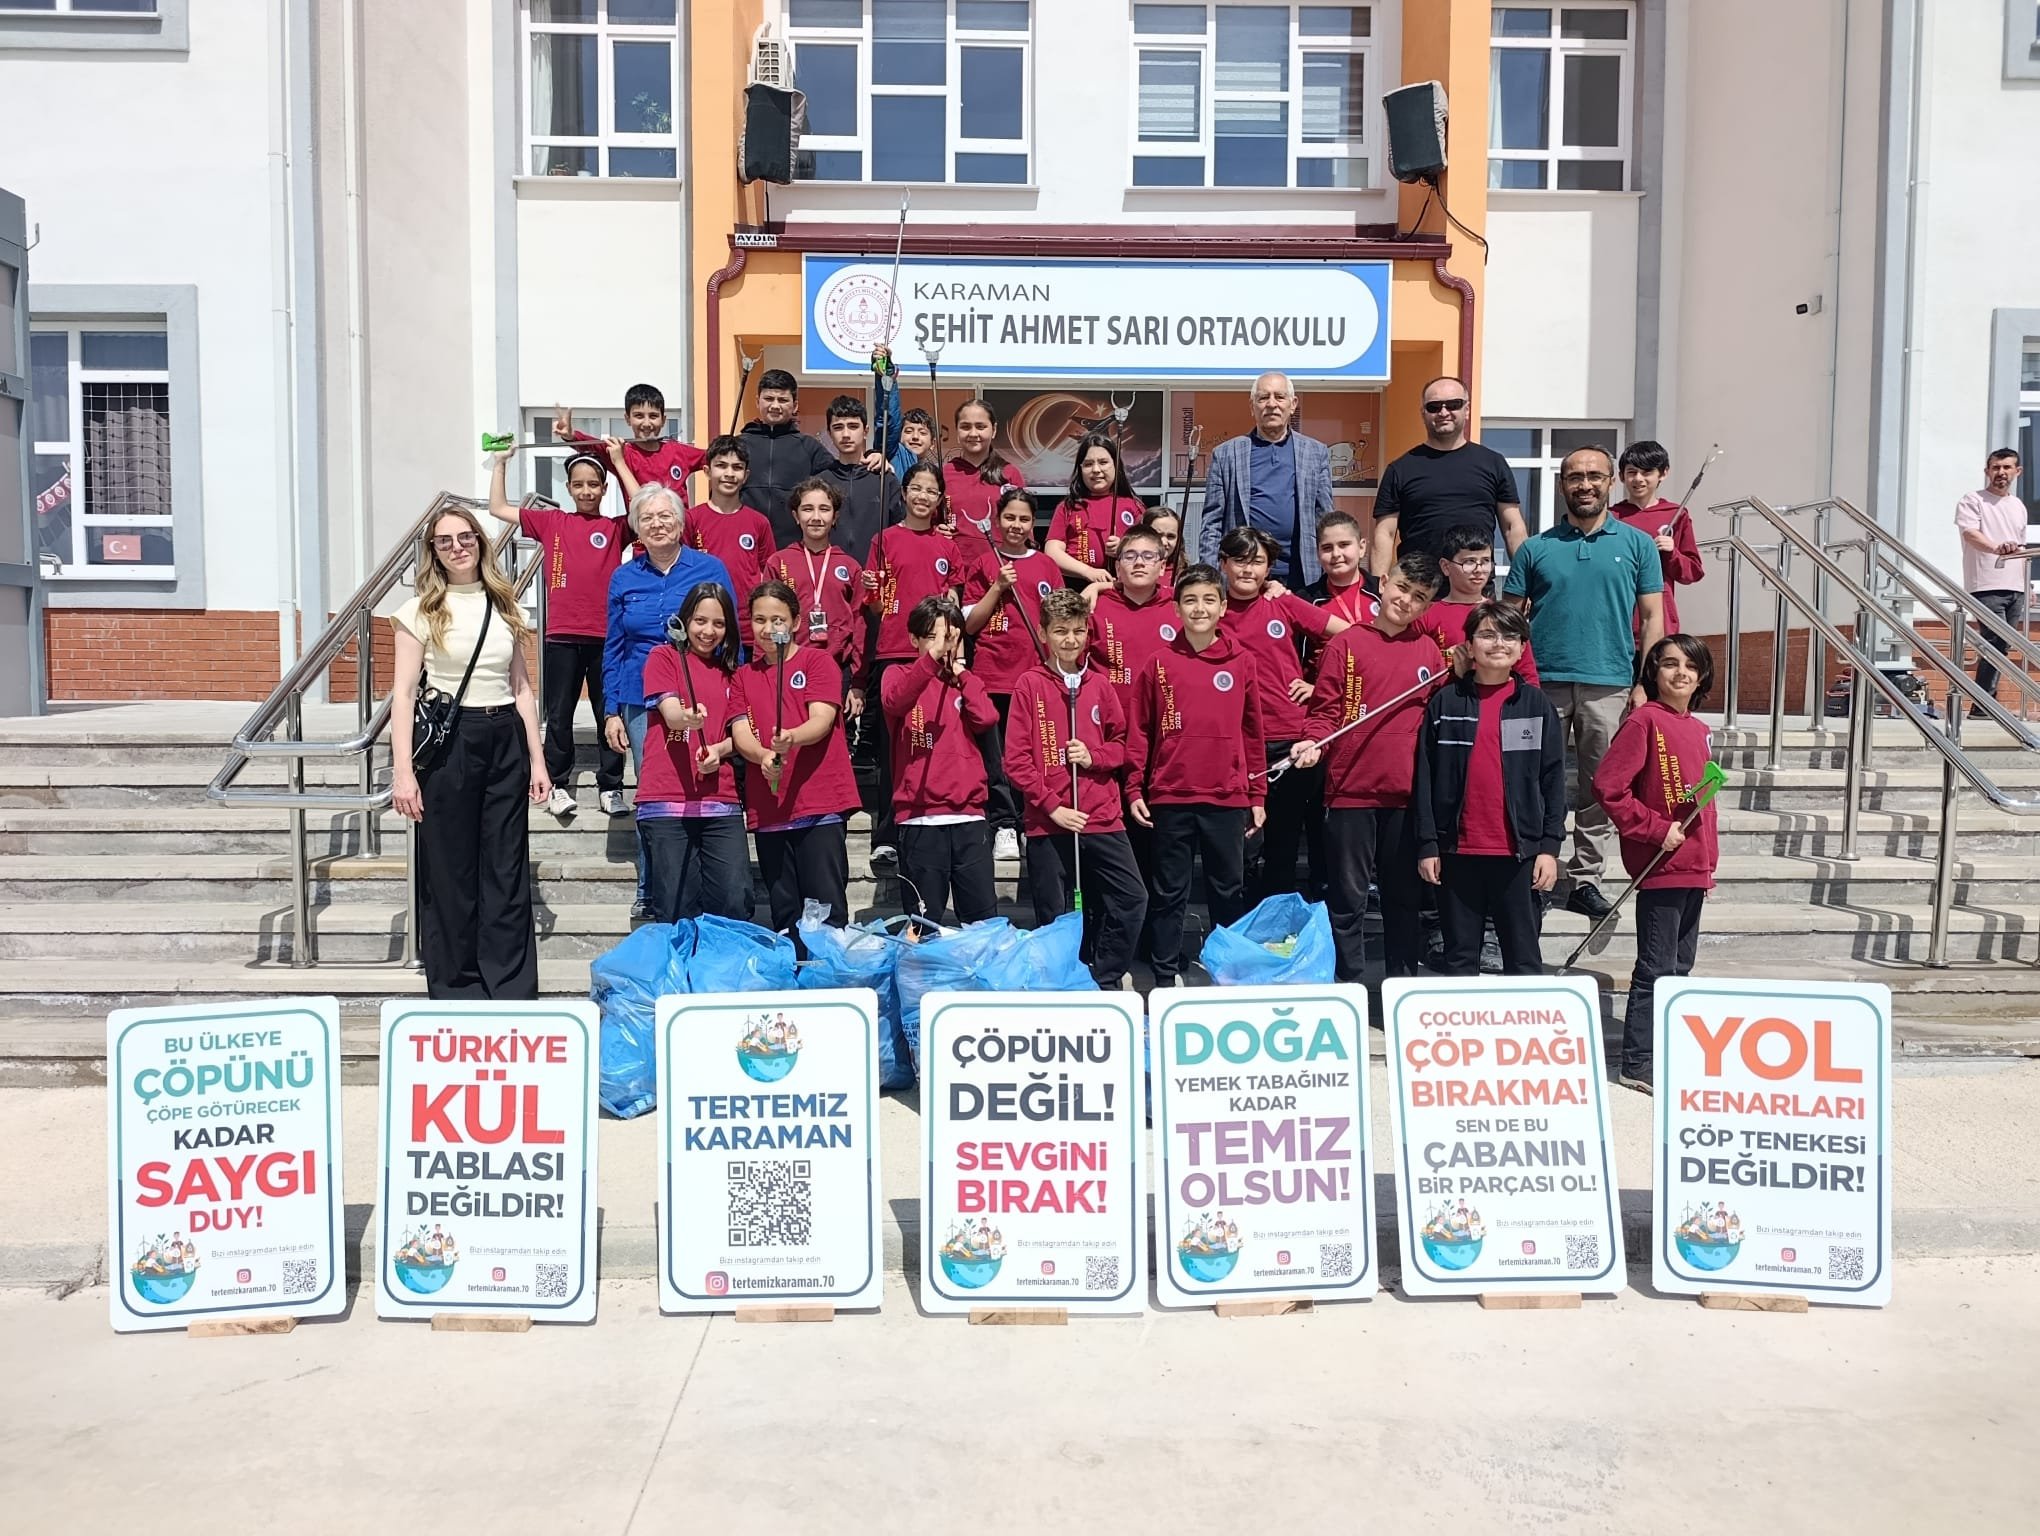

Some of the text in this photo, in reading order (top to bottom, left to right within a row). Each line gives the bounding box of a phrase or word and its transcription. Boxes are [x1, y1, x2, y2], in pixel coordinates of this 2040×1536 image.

[915, 283, 1050, 301] KARAMAN
[915, 307, 993, 350] ŞEHİT
[1000, 315, 1099, 344] AHMET
[1107, 316, 1168, 346] SARI
[1176, 316, 1346, 346] ORTAOKULU
[1116, 641, 1124, 684] ORTAOKULU
[1346, 674, 1354, 700] AHMET
[1350, 676, 1362, 720] ORTAOKULU
[1038, 700, 1052, 766] ŞEHİT AHMET SARI
[1048, 720, 1058, 766] ORTAOKULU
[1656, 734, 1666, 752] SARI
[1058, 748, 1066, 766] 2023
[1659, 754, 1670, 781] AHMET
[1670, 755, 1685, 804] ORTAOKULU
[1684, 784, 1694, 803] 223
[1419, 1010, 1566, 1029] ÇOCUKLARINA
[164, 1031, 282, 1053] BU ÜLKEYE
[409, 1029, 568, 1063] TÜRKİYE
[952, 1028, 1111, 1068] ÇÖPÜNÜ
[1175, 1007, 1348, 1065] DOĞA
[1681, 1015, 1863, 1083] YOL
[1405, 1029, 1586, 1072] ÇÖP DAĞI
[133, 1050, 314, 1105] ÇÖPÜNÜ
[1175, 1070, 1349, 1093] YEMEK TABAĞINIZ
[950, 1072, 1114, 1121] DEĞİL!
[1229, 1096, 1297, 1112] KADAR
[1411, 1078, 1588, 1107] BIRAKMA!
[1680, 1089, 1865, 1120] KENARLARI
[147, 1099, 300, 1124] ÇÖPE GÖTÜRECEK
[411, 1069, 565, 1144] KÜL
[174, 1124, 274, 1151] KADAR
[685, 1124, 852, 1151] KARAMAN
[1456, 1119, 1548, 1133] SEN DE BU
[1680, 1124, 1733, 1149] ÇÖP
[407, 1150, 564, 1181] TABLASI
[1423, 1140, 1586, 1174] ÇABANIN
[136, 1150, 315, 1208] SAYGI
[1180, 1167, 1350, 1208] OLSUN!
[1460, 1175, 1554, 1197] PARÇASI
[1561, 1175, 1597, 1192] OL!
[958, 1180, 1107, 1213] BIRAK!
[189, 1205, 263, 1233] DUY!
[719, 1256, 733, 1264] Bizi
[735, 1256, 784, 1265] instagramdan
[786, 1255, 803, 1265] takip
[1254, 1267, 1314, 1277] tertemizkaraman.70
[1499, 1257, 1561, 1266] tertemizkaraman.70
[1756, 1263, 1822, 1275] tertemizkaraman.70
[211, 1284, 277, 1297] tertemizkaraman.70
[468, 1283, 529, 1293] tertemizkaraman.70
[732, 1275, 835, 1290] tertemizkaraman.70
[1017, 1277, 1079, 1287] tertemizkaraman.70
